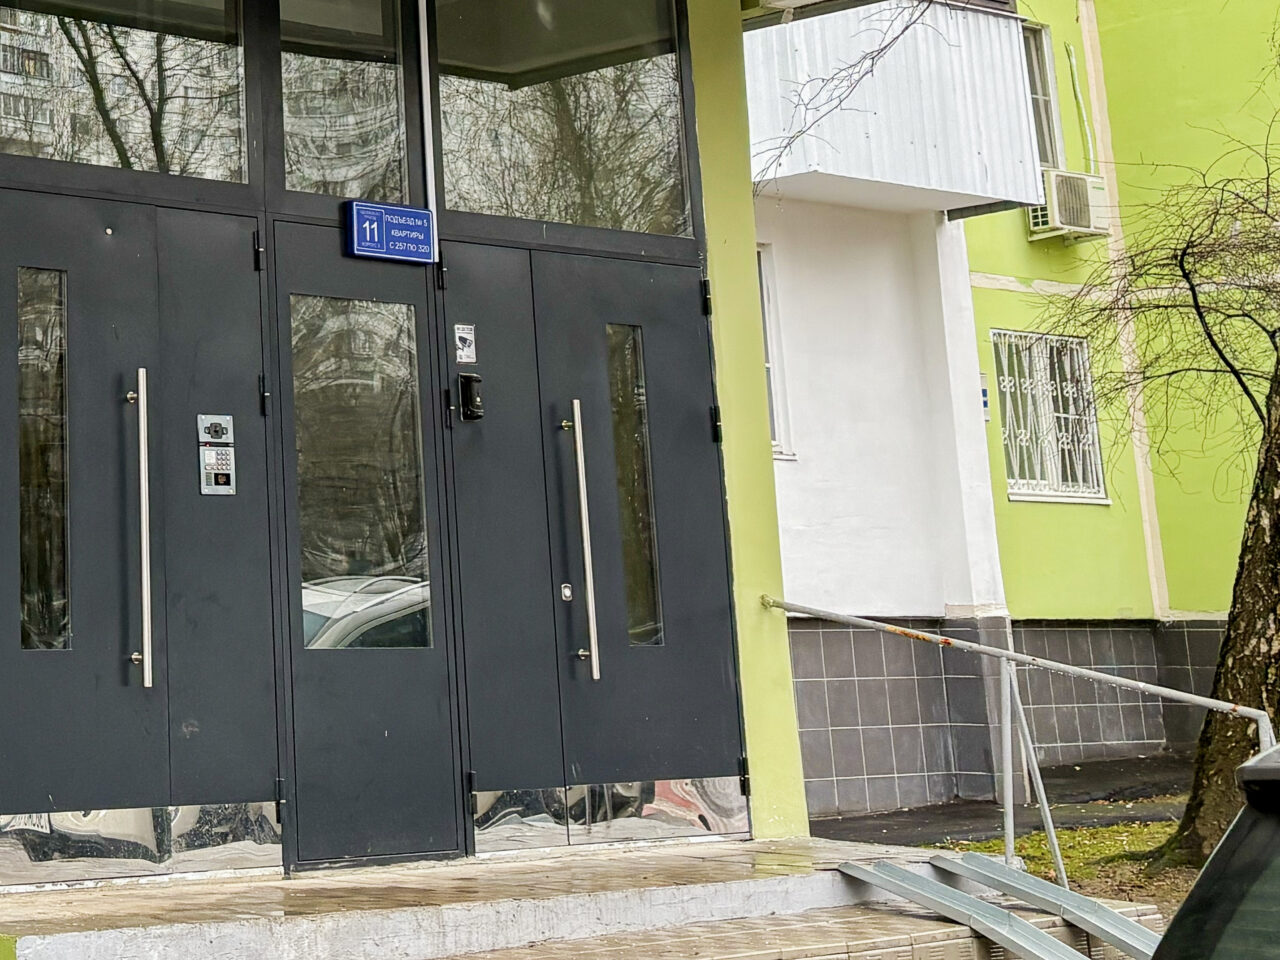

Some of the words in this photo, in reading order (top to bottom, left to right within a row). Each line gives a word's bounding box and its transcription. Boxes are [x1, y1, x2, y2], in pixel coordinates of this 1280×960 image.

[385, 214, 415, 226] ПОДЪЕЗД
[423, 219, 428, 227] 5
[362, 220, 378, 242] 11
[391, 229, 424, 240] КВАРТИРЫ
[389, 241, 395, 249] С
[395, 241, 407, 250] 257
[407, 243, 417, 252] ПО
[417, 244, 430, 253] 320
